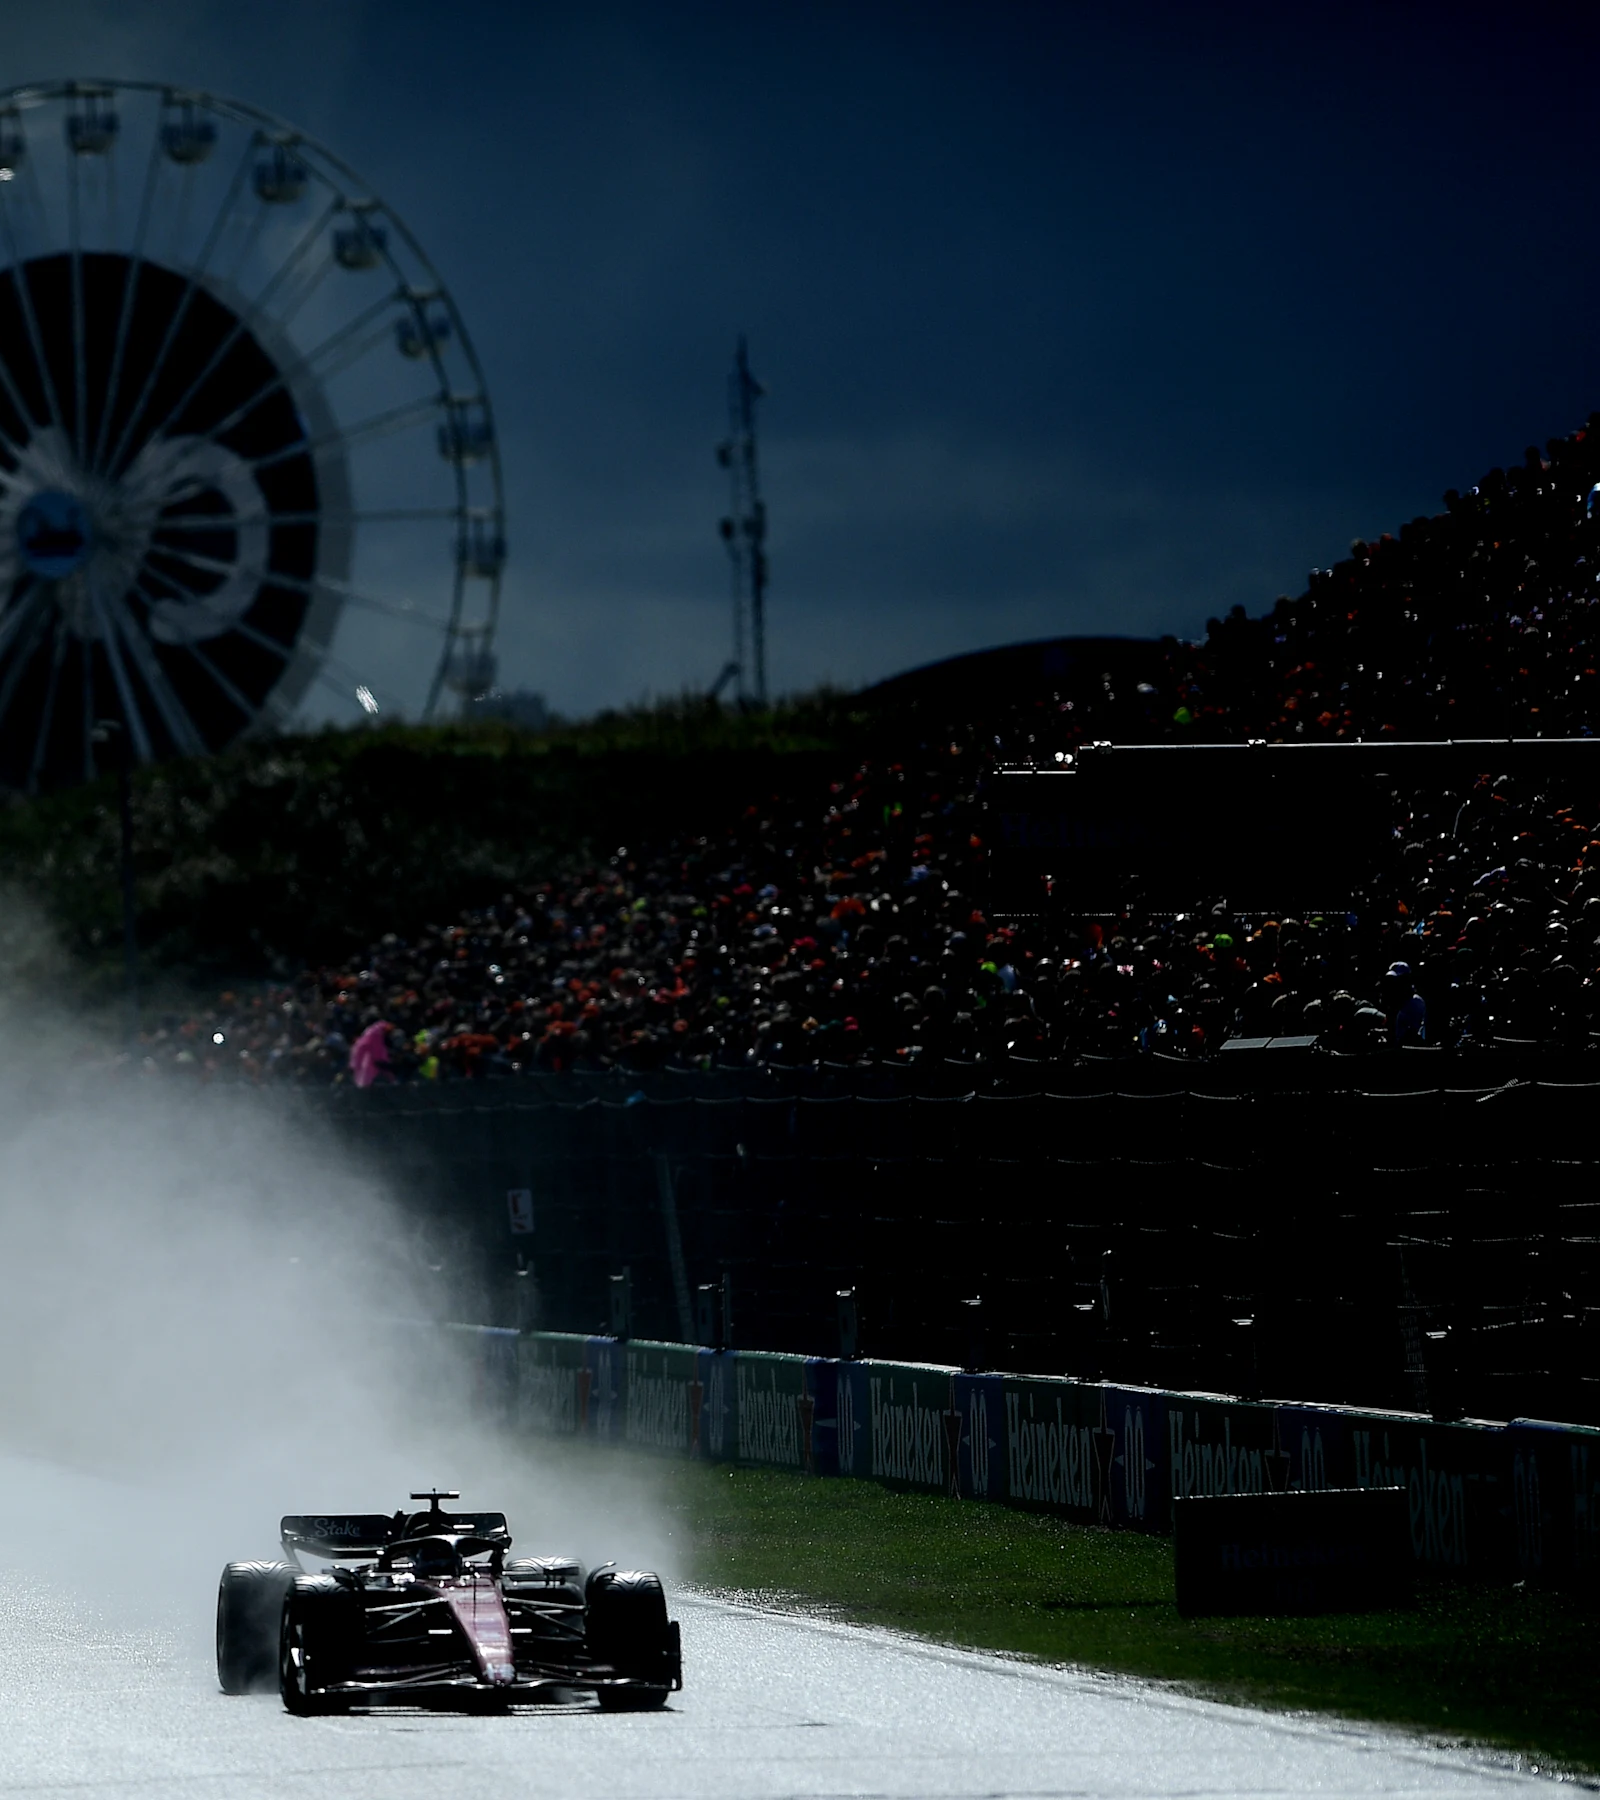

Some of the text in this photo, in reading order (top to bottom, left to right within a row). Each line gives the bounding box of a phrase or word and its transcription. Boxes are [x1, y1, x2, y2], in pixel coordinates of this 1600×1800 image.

[626, 1351, 687, 1448] Heineken
[736, 1362, 800, 1465] Heineken
[870, 1375, 944, 1486] Heineken
[1006, 1391, 1092, 1508] Heineken
[314, 1517, 361, 1538] Stake
